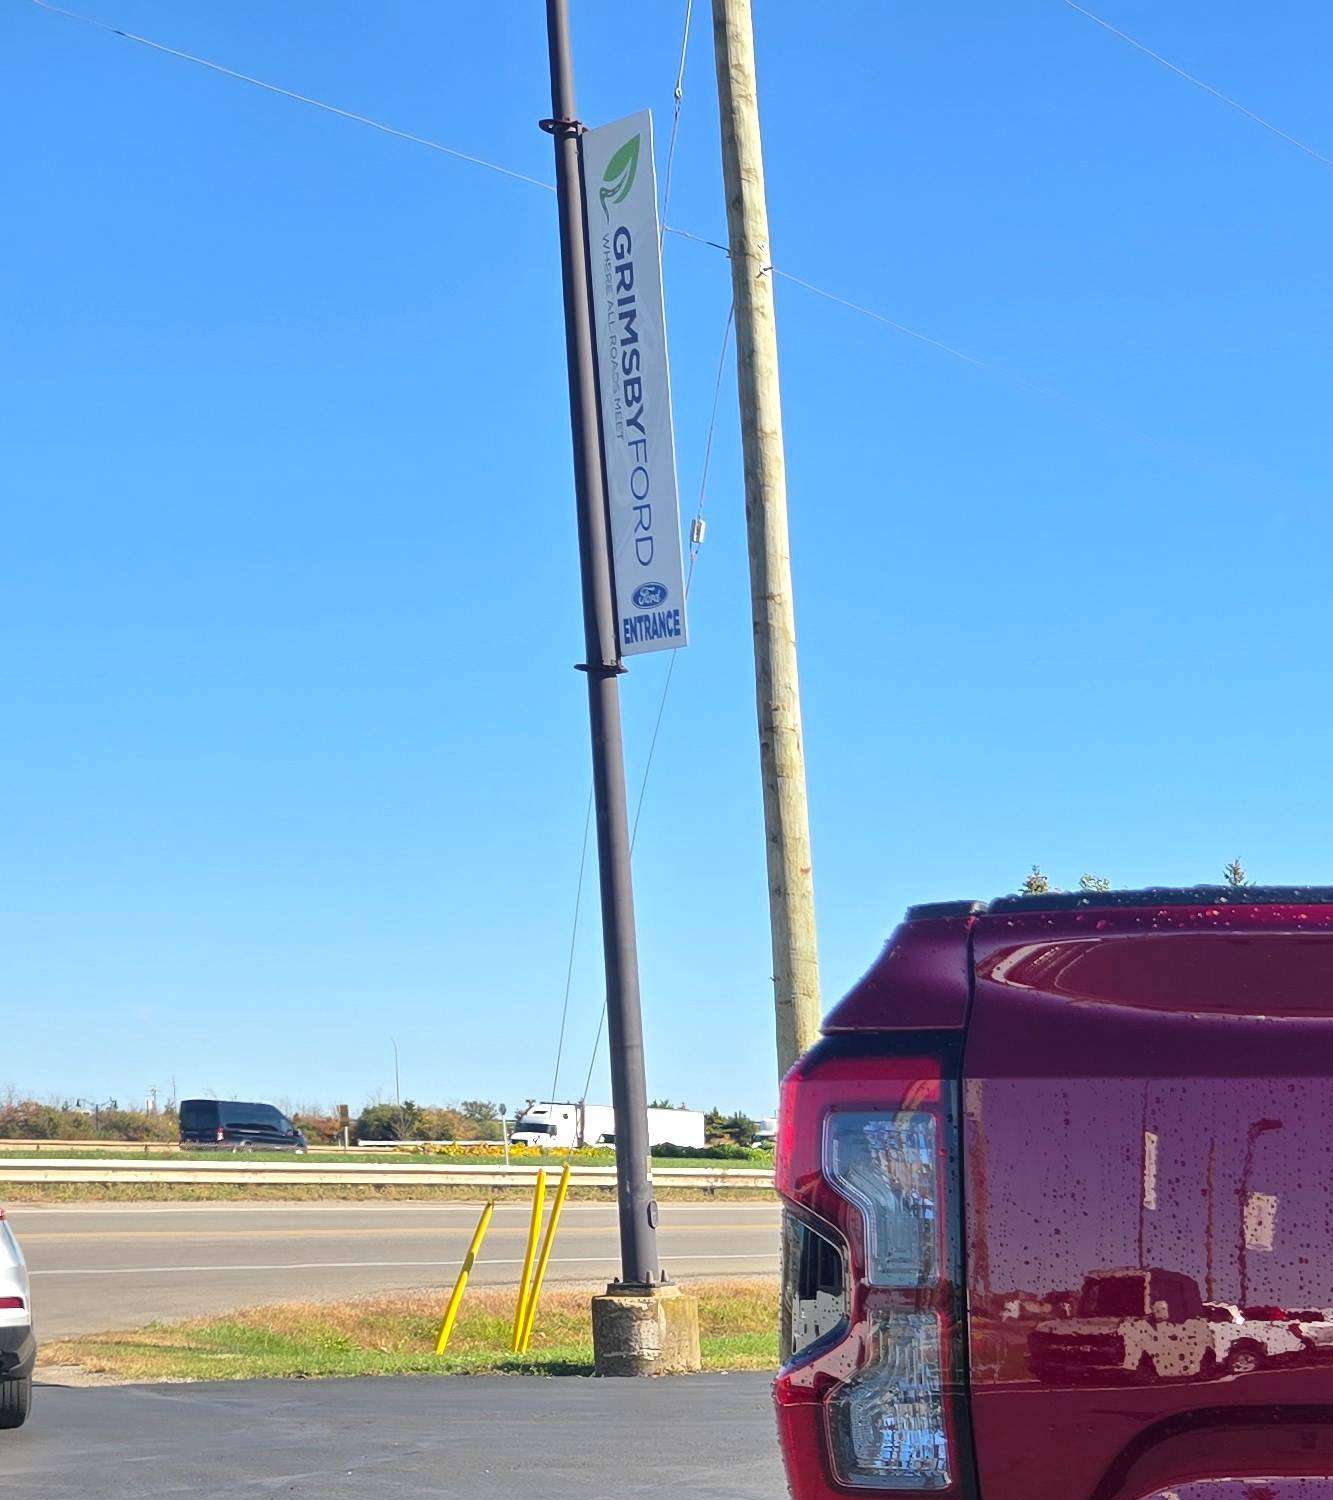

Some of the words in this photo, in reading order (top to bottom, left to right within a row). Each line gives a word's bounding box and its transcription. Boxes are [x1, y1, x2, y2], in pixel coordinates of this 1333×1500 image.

[607, 300, 617, 331] ALL
[614, 397, 625, 439] MEET
[612, 225, 654, 567] GRIMSBYFORD
[623, 609, 681, 645] ENTRANCE
[638, 586, 662, 605] Ford
